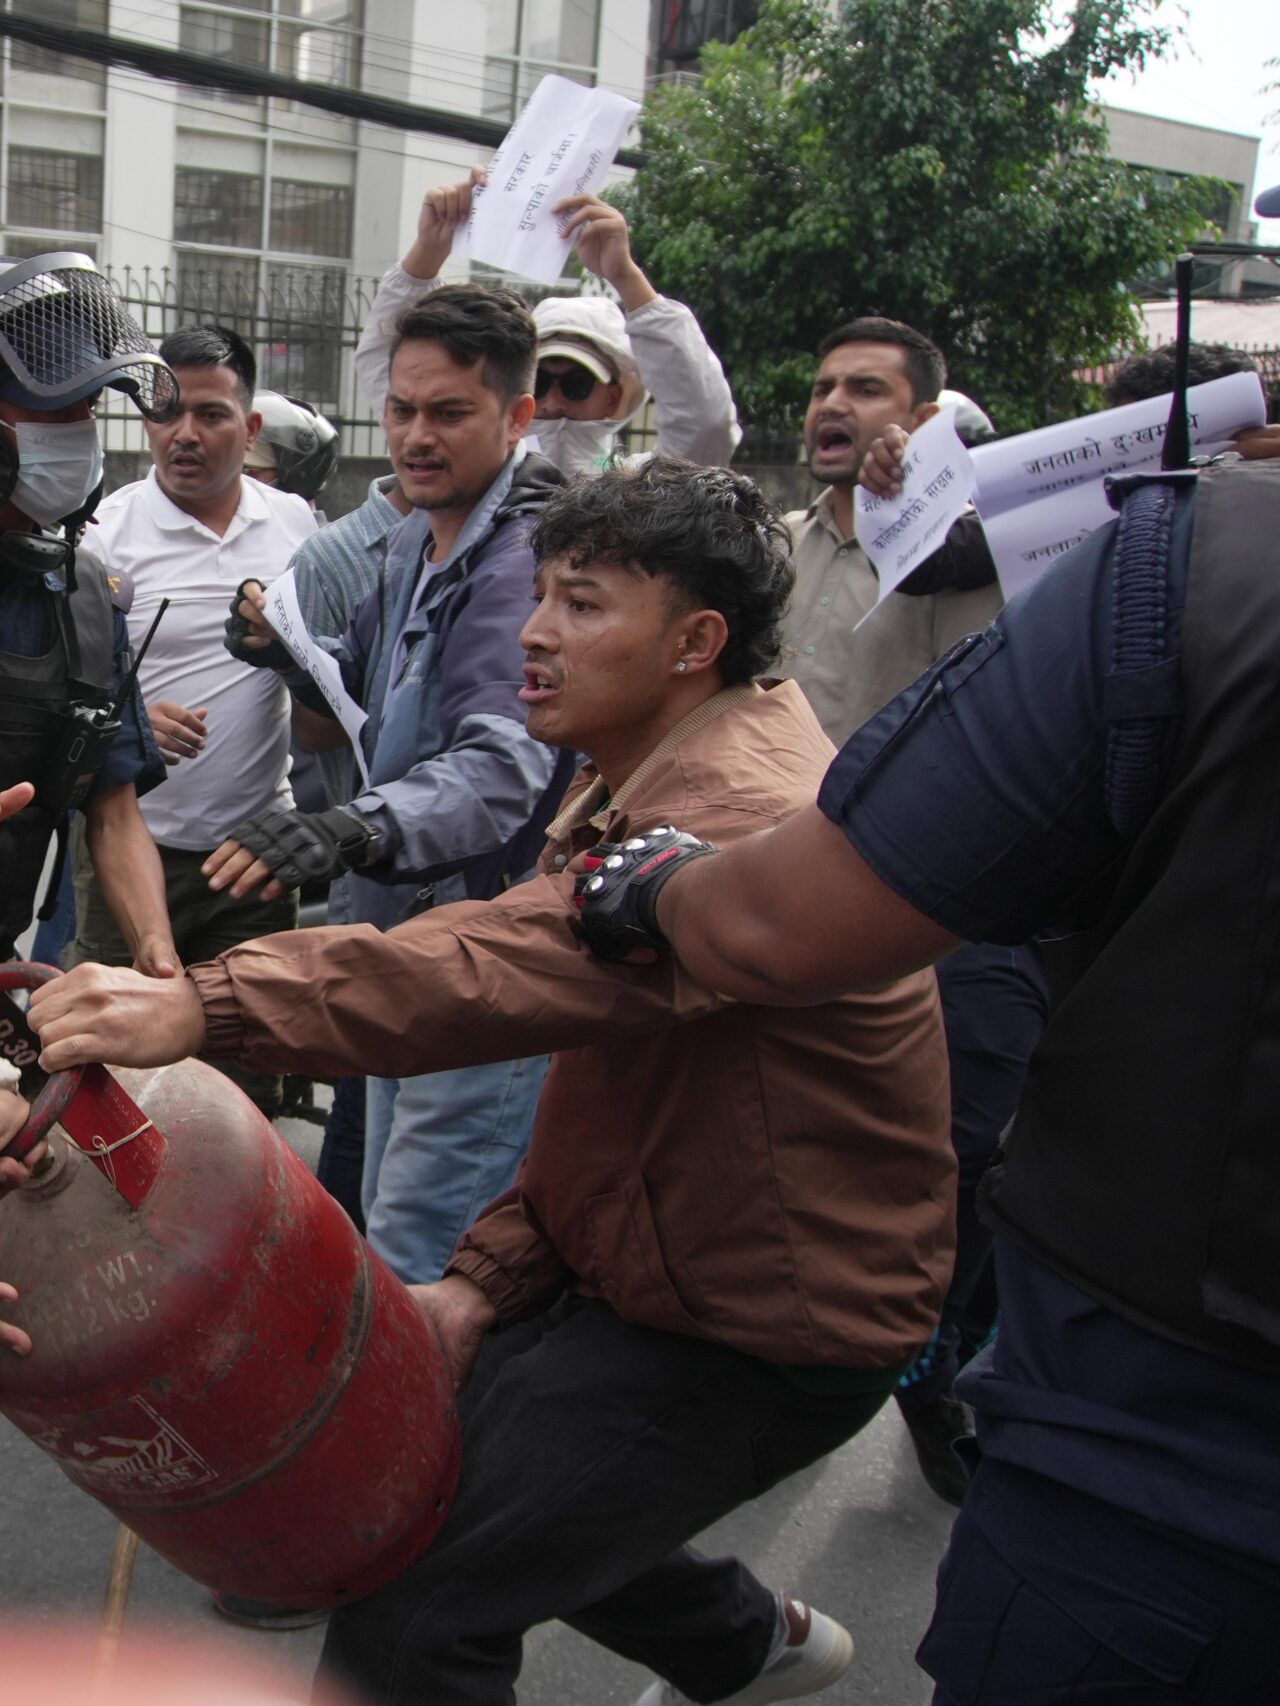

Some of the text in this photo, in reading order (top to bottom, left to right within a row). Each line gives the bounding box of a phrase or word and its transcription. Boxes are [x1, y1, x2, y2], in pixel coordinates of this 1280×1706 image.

[504, 151, 534, 192] सरकार
[1023, 436, 1103, 476] जनताको
[923, 463, 957, 499] संरक्षक
